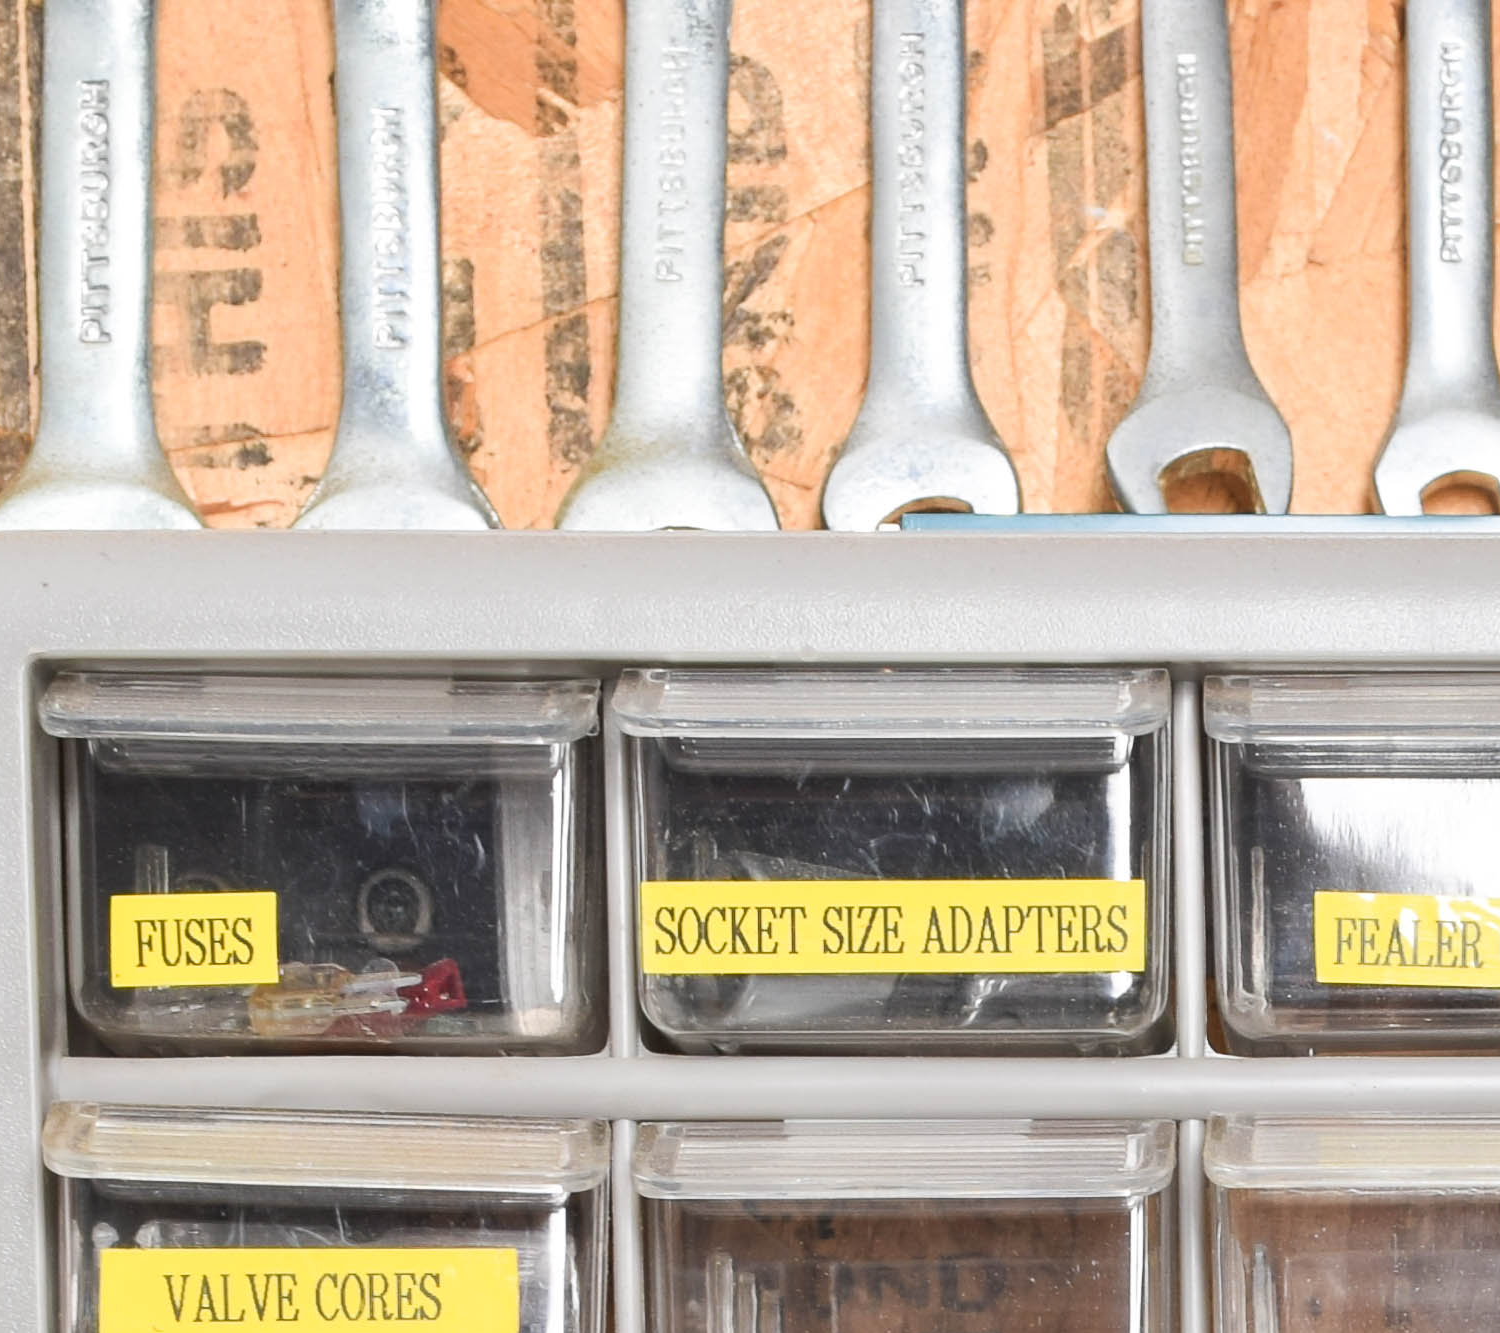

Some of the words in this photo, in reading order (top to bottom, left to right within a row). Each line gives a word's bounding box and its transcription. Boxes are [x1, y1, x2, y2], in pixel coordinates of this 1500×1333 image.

[77, 79, 112, 344] PITTSBURGH
[896, 33, 925, 287] PITTSBURGH
[1177, 53, 1204, 265] PITTSBURGH
[1440, 42, 1462, 263] PITTSBURGH
[135, 918, 253, 967] FUSES
[655, 907, 806, 954] SOCKET
[823, 906, 904, 953] SIZE
[922, 906, 1127, 953] ADAPTERS
[1334, 918, 1483, 969] FEALER
[164, 1274, 299, 1322] VALVE
[316, 1273, 441, 1321] CORES
